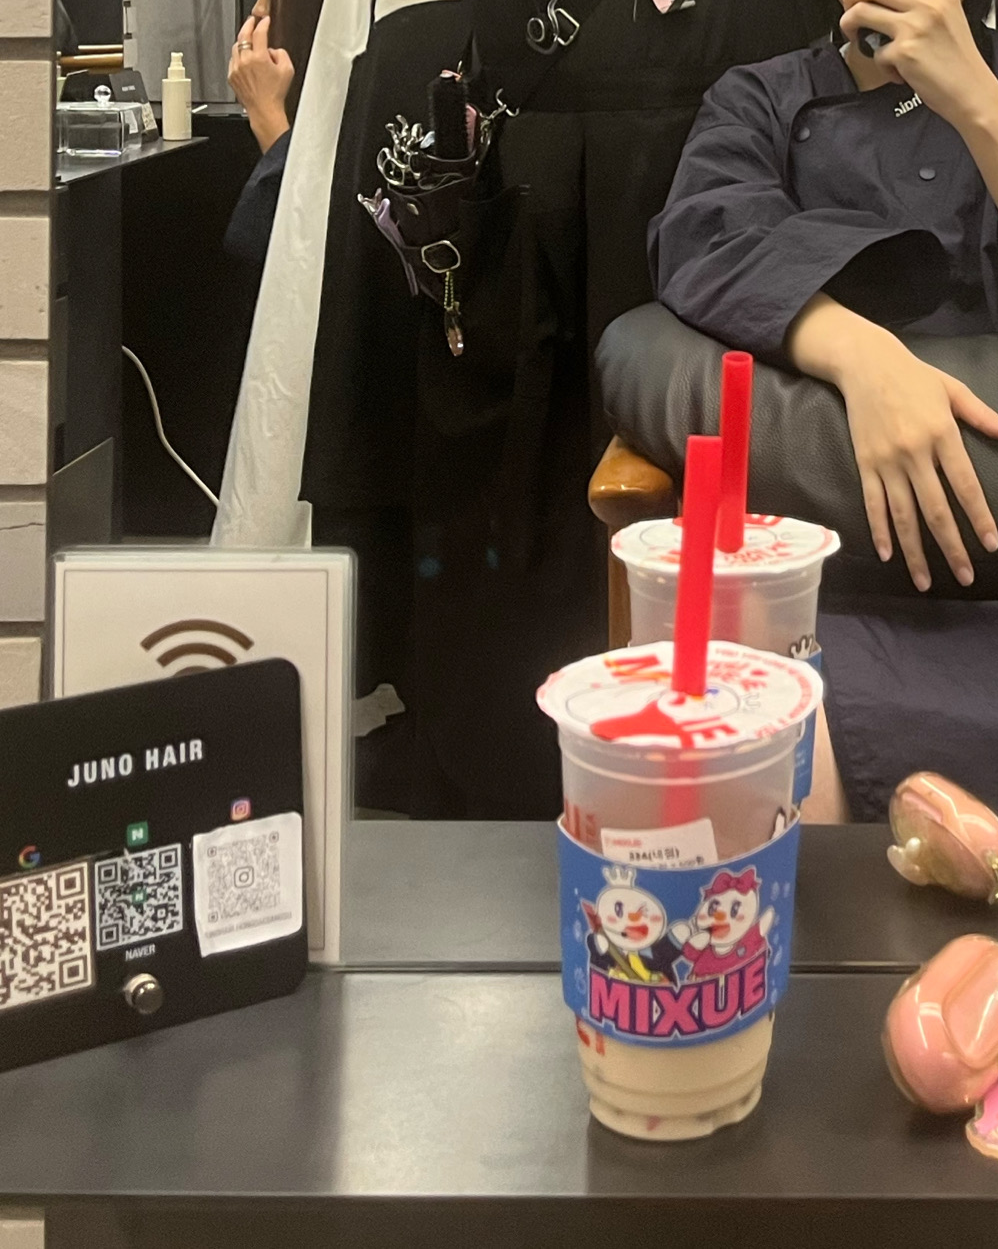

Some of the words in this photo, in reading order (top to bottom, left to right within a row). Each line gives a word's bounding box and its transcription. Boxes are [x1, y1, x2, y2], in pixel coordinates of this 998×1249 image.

[67, 753, 133, 788] JUNO
[145, 739, 204, 771] HAIR
[125, 944, 155, 961] NAVER
[590, 954, 766, 1036] MIXUE
